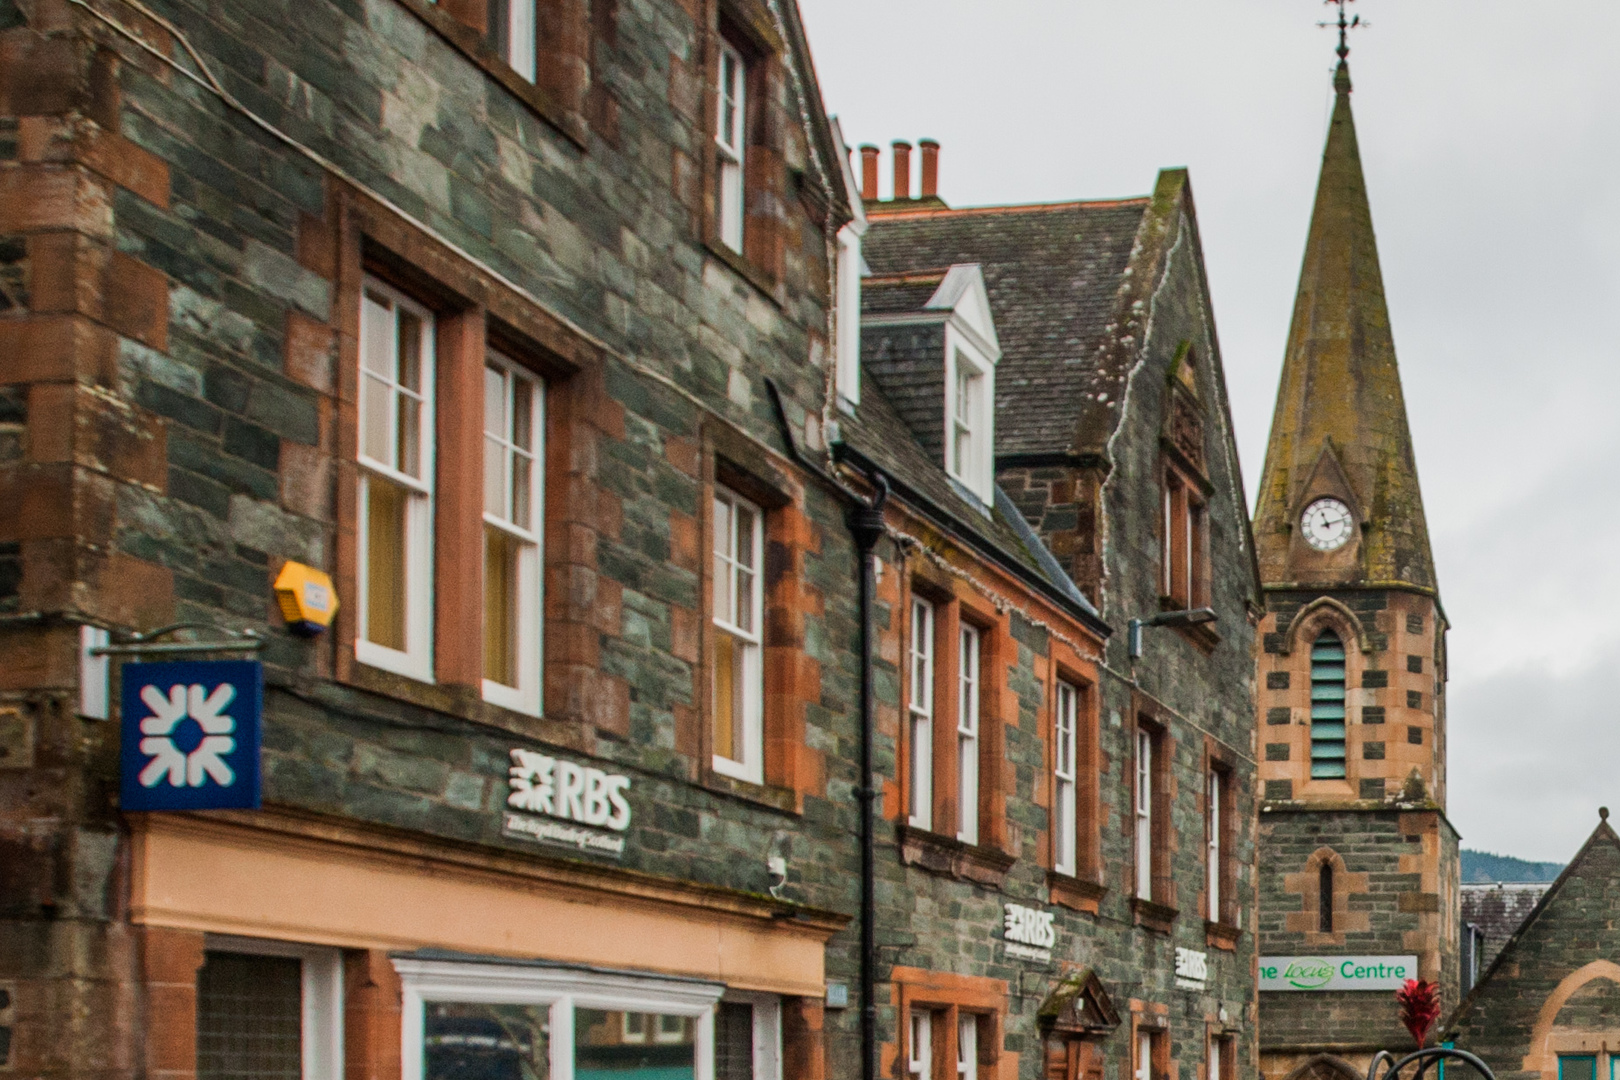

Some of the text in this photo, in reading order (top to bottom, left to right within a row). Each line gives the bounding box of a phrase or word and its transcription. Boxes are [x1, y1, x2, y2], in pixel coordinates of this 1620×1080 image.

[558, 760, 632, 831] RBS
[1025, 907, 1056, 949] RBS
[1189, 949, 1207, 981] RBS
[1340, 961, 1406, 979] Centre
